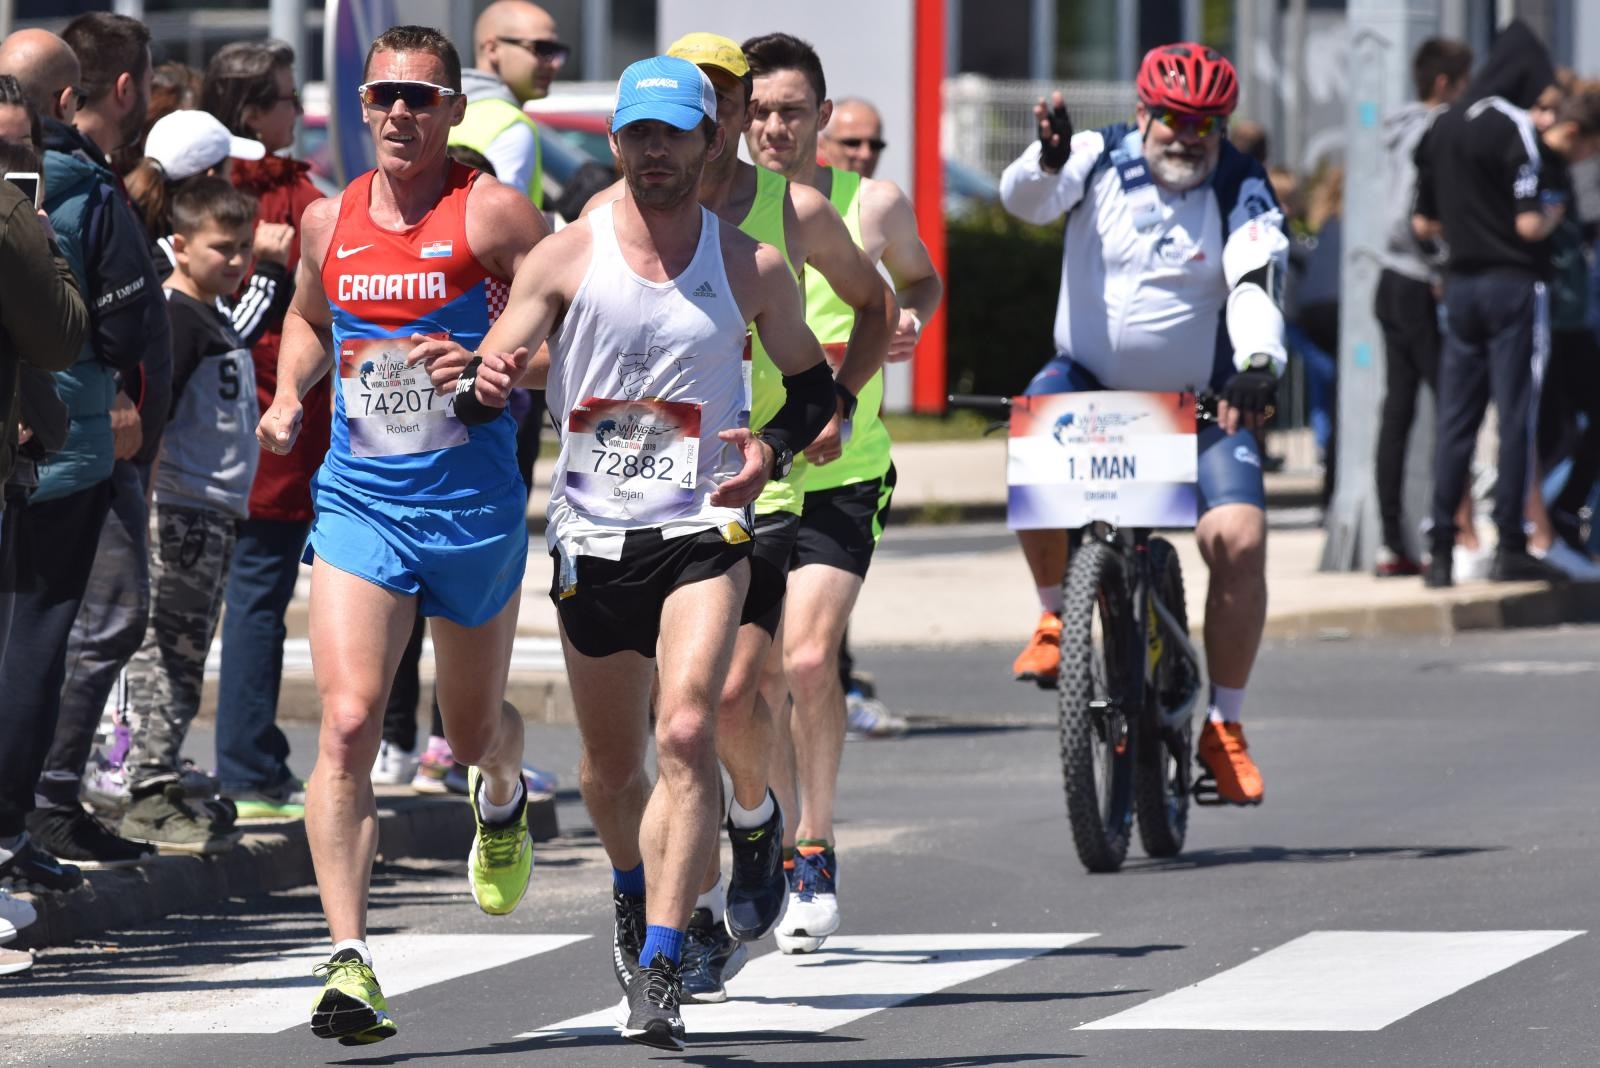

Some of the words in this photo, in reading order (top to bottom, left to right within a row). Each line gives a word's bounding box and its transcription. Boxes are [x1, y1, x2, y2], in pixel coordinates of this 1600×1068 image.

[338, 271, 446, 301] CROATIA
[382, 370, 402, 380] LIFE
[360, 387, 435, 417] 74207
[386, 423, 421, 435] Robert
[618, 424, 656, 435] WINGS
[608, 440, 629, 449] WORLD
[629, 441, 641, 450] RUN
[591, 449, 674, 481] 72882
[1069, 457, 1084, 481] 1.
[1090, 455, 1136, 480] MAN
[681, 471, 693, 488] 4
[613, 487, 644, 500] Dejan
